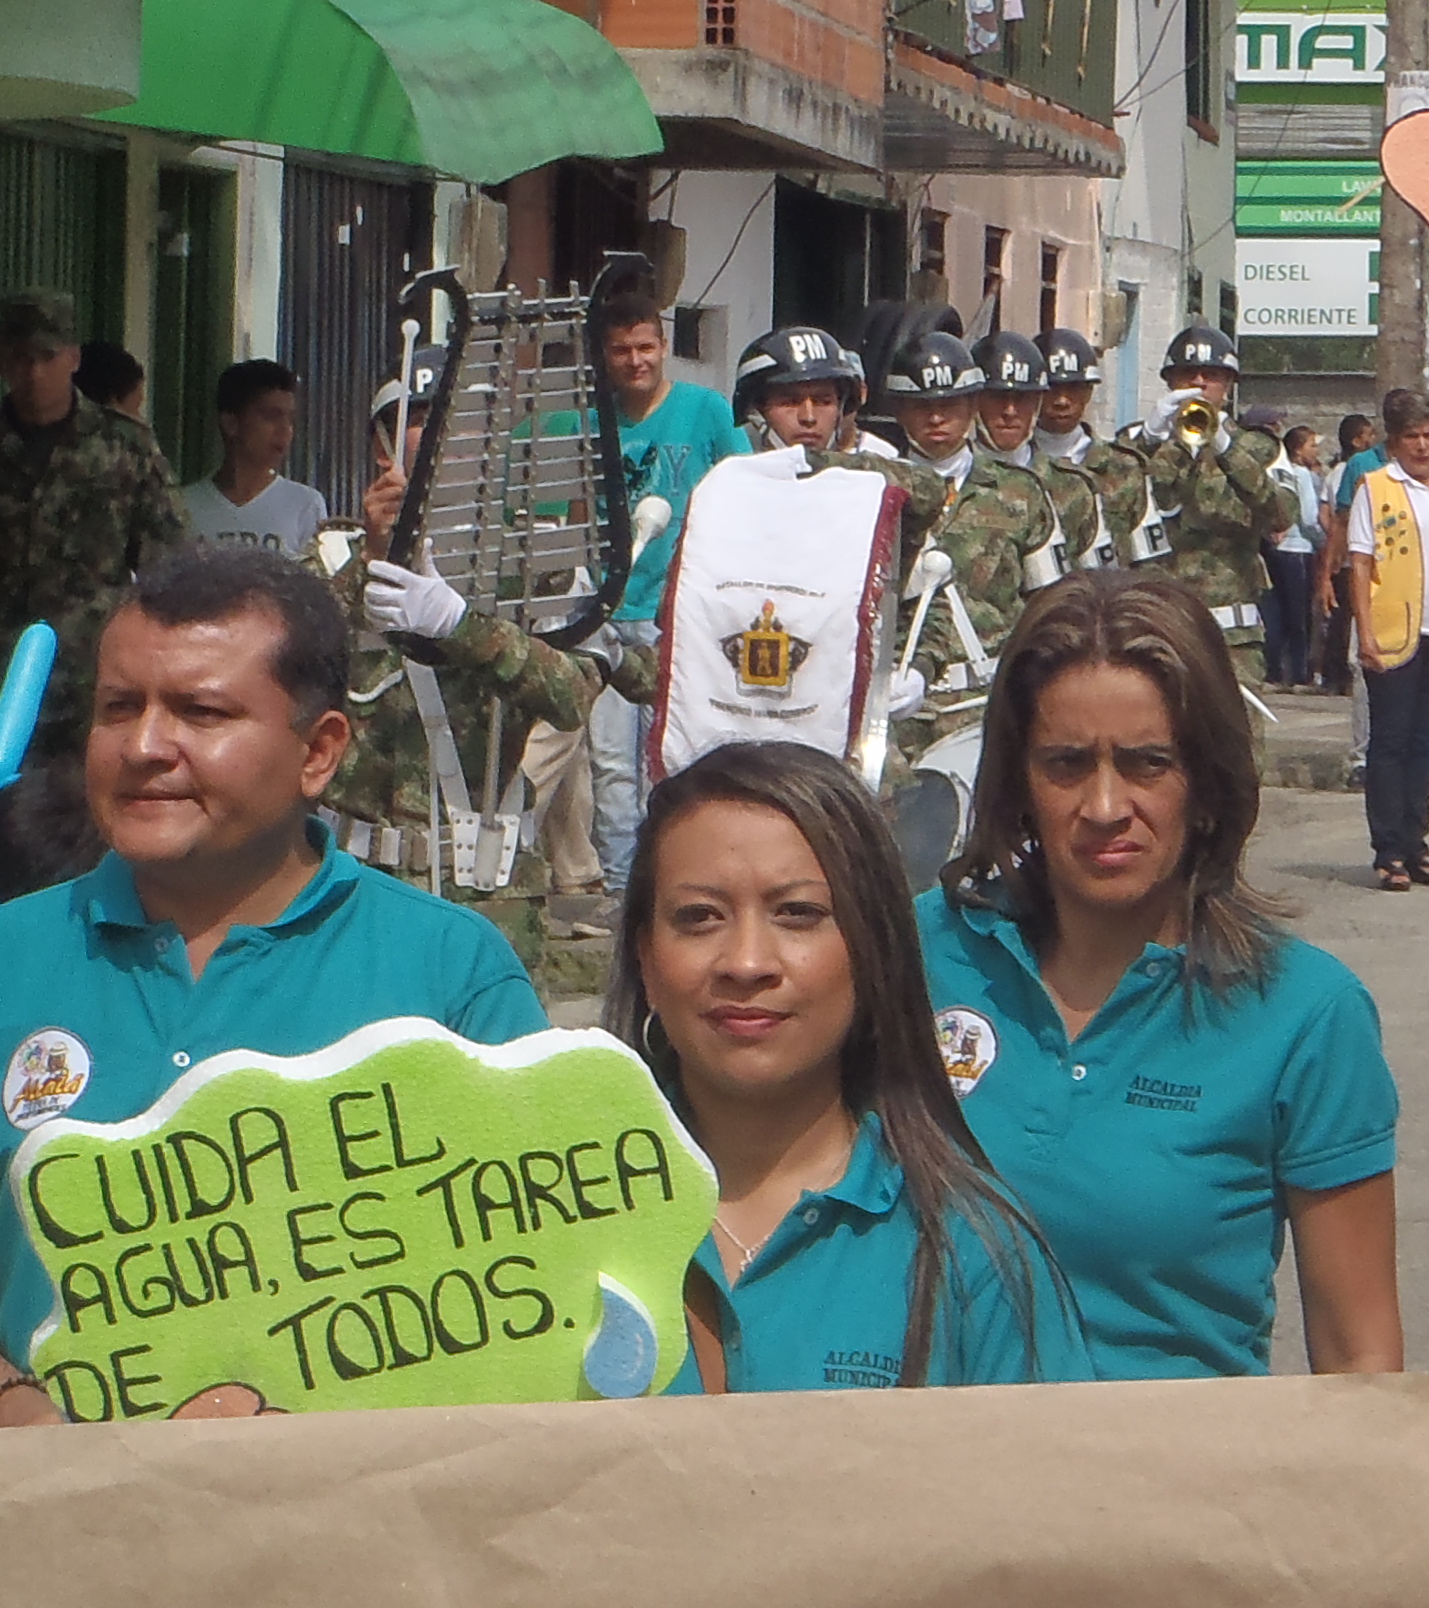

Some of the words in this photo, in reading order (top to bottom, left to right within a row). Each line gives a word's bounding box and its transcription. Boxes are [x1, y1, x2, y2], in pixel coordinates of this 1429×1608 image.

[1243, 264, 1311, 282] DIESEL
[1243, 307, 1358, 326] CORRIENTE
[788, 333, 828, 363] PM
[1184, 343, 1212, 362] PM
[921, 365, 953, 389] PM
[1000, 360, 1030, 382] PM
[27, 1106, 300, 1250] CUIDA
[328, 1082, 446, 1181] EL
[285, 1192, 406, 1283] ES
[415, 1127, 675, 1250] TAREA
[43, 1344, 169, 1424] DE
[267, 1255, 576, 1391] TODOS.
